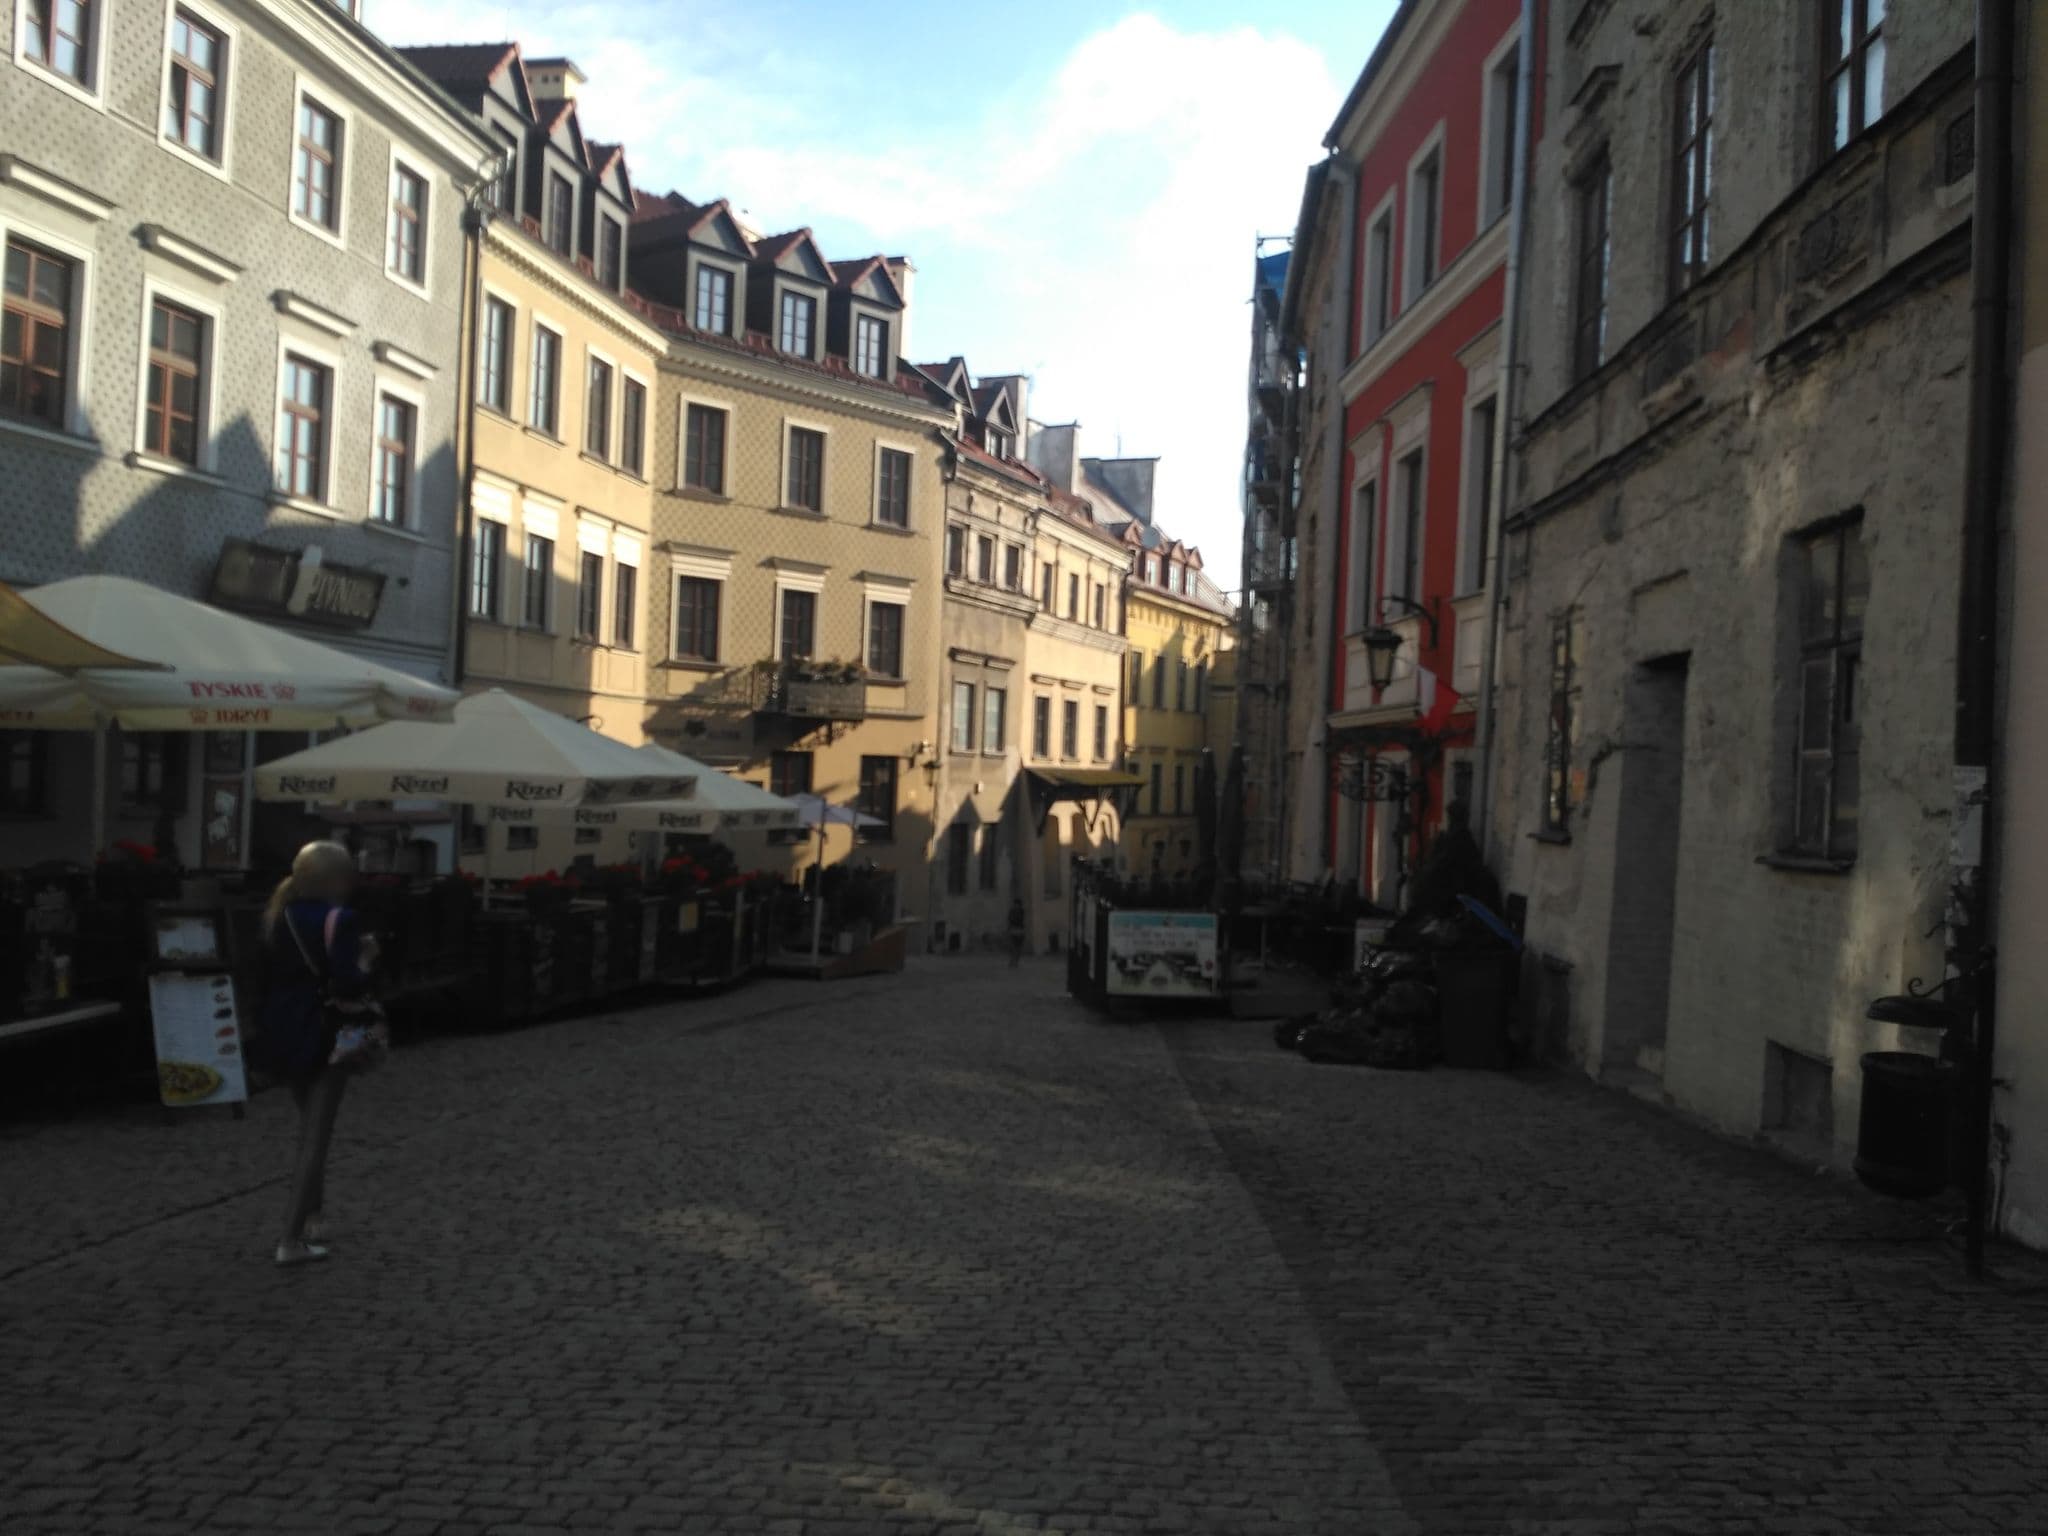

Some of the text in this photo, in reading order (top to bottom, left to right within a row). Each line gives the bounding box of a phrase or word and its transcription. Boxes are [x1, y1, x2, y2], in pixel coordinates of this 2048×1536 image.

[187, 681, 266, 698] TYSKIE
[279, 775, 336, 794] Kozel
[391, 775, 449, 794] Kozel
[505, 780, 563, 800] Kozel
